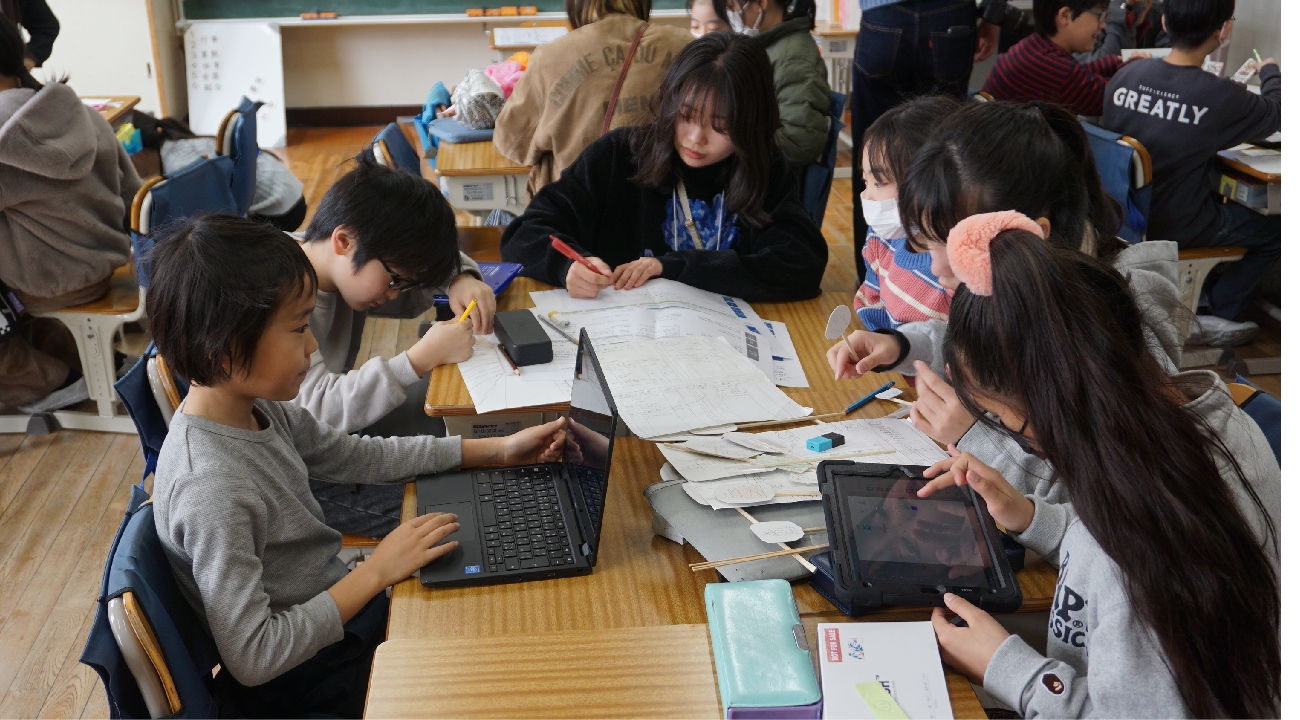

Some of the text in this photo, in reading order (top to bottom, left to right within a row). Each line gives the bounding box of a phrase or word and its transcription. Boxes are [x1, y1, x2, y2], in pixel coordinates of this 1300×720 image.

[550, 52, 598, 108] COMME
[1113, 87, 1209, 125] GREATLY
[828, 629, 839, 661] NOT FOR SALE
